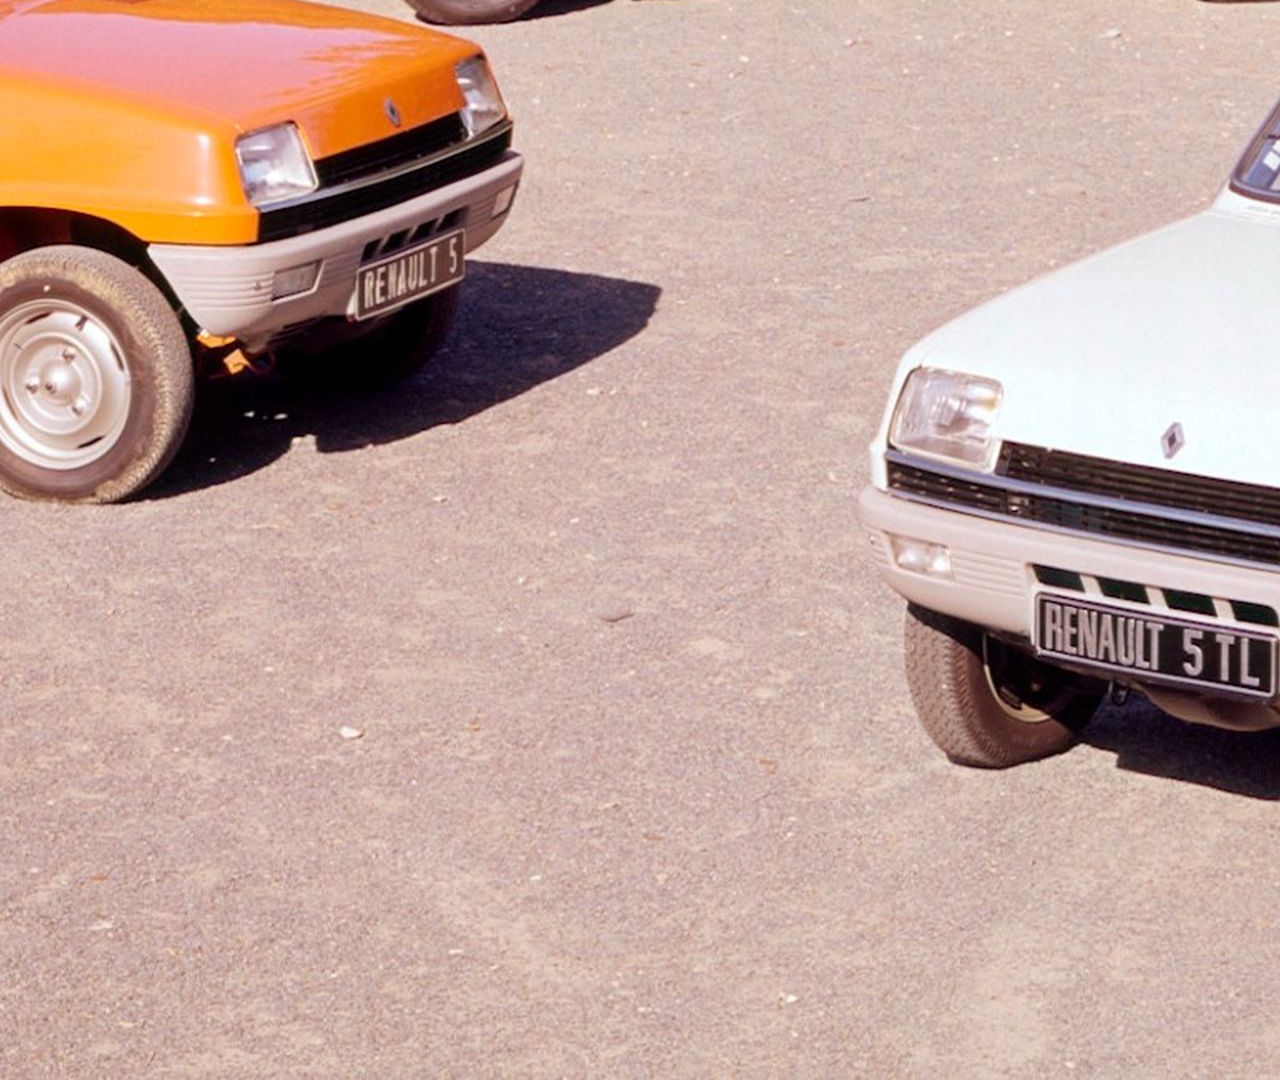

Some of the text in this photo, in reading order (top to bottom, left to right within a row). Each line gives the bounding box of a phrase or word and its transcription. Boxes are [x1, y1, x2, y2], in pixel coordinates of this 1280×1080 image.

[364, 237, 457, 309] RENAULT 5
[1044, 602, 1260, 686] RENAULT 5 TL
